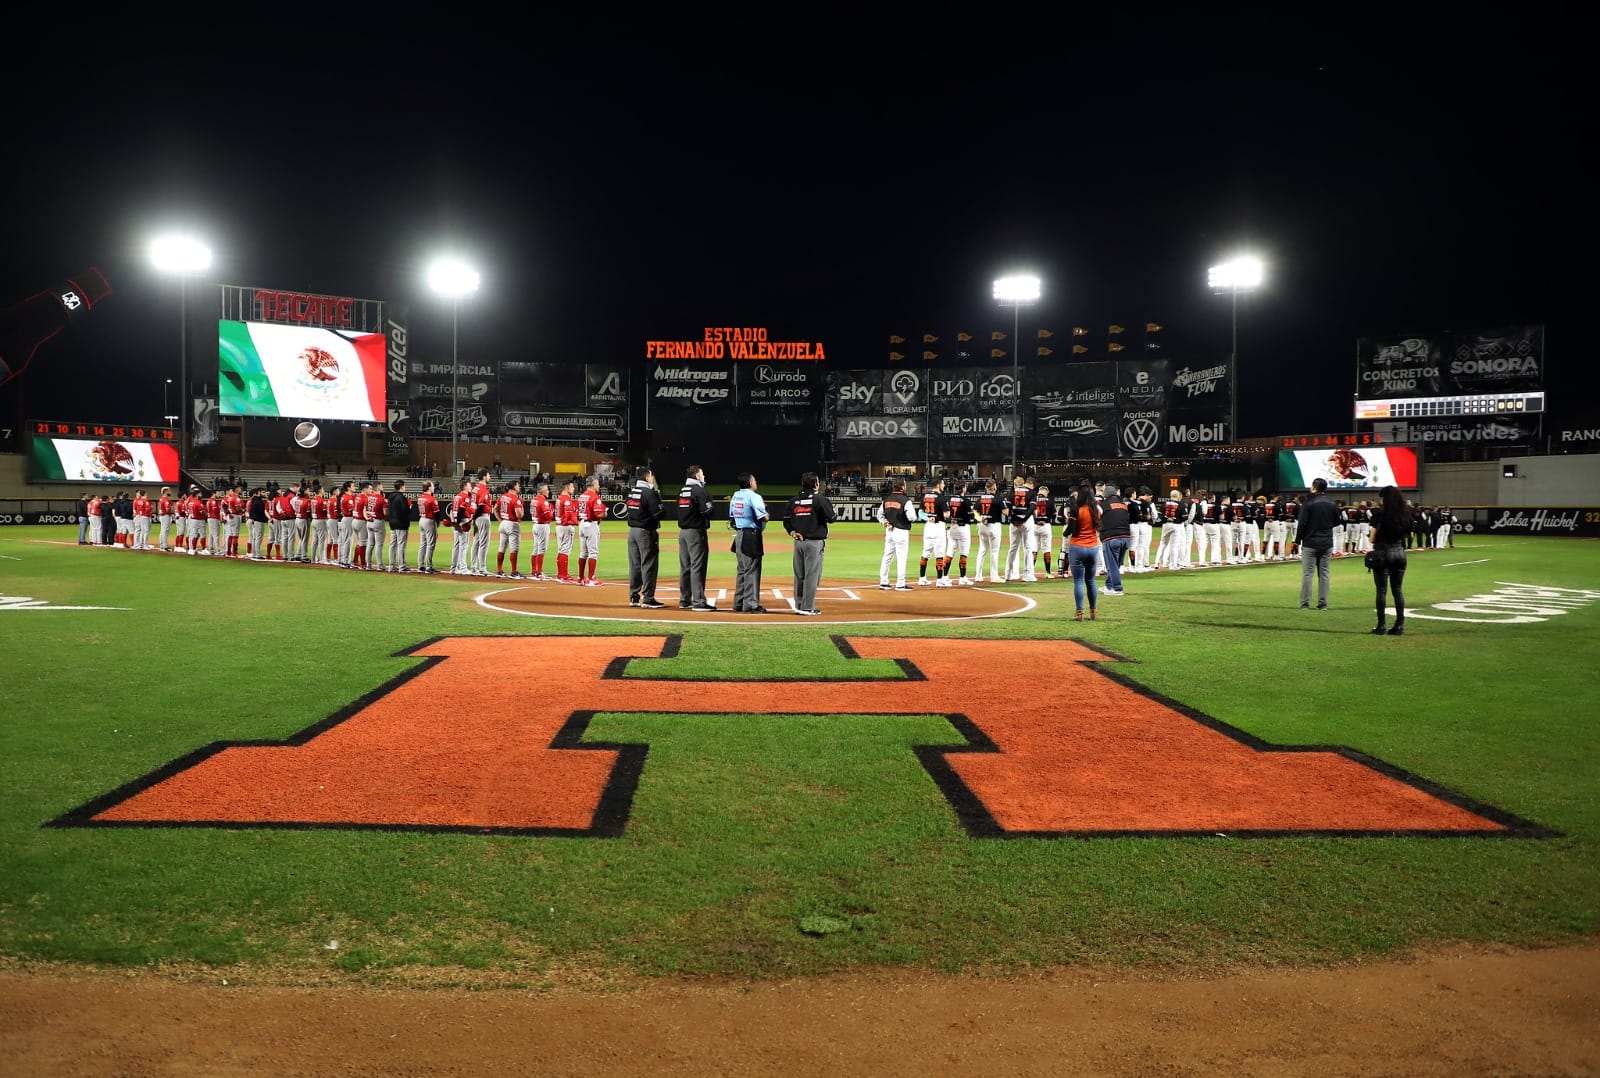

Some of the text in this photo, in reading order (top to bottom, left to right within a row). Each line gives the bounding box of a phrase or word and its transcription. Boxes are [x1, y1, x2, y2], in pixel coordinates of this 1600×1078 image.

[254, 290, 355, 325] TECATE
[704, 327, 767, 341] ESTADIO
[388, 320, 407, 383] telcel
[646, 341, 826, 360] FERNANDO VALENZUELA
[412, 363, 495, 376] EL IMPARCIAL
[1449, 356, 1538, 375] SONORA
[663, 367, 728, 383] Hidrogas
[756, 366, 806, 382] Kuroda
[1362, 368, 1439, 381] CONCRETOS
[774, 389, 800, 398] ARCO
[840, 381, 876, 404] sky
[1119, 386, 1165, 394] MEDIA
[1187, 380, 1217, 398] FLOW
[1383, 380, 1417, 391] KINO
[656, 386, 729, 404] Albatros
[1076, 391, 1115, 402] inteligis
[37, 423, 49, 433] 21
[57, 424, 69, 434] 10
[846, 420, 898, 435] ARCO
[960, 418, 1006, 432] CIMA
[1169, 423, 1224, 442] Mobil
[1409, 424, 1519, 442] benavides
[38, 515, 66, 524] ARCO
[1490, 509, 1580, 531] Salsa Huichol
